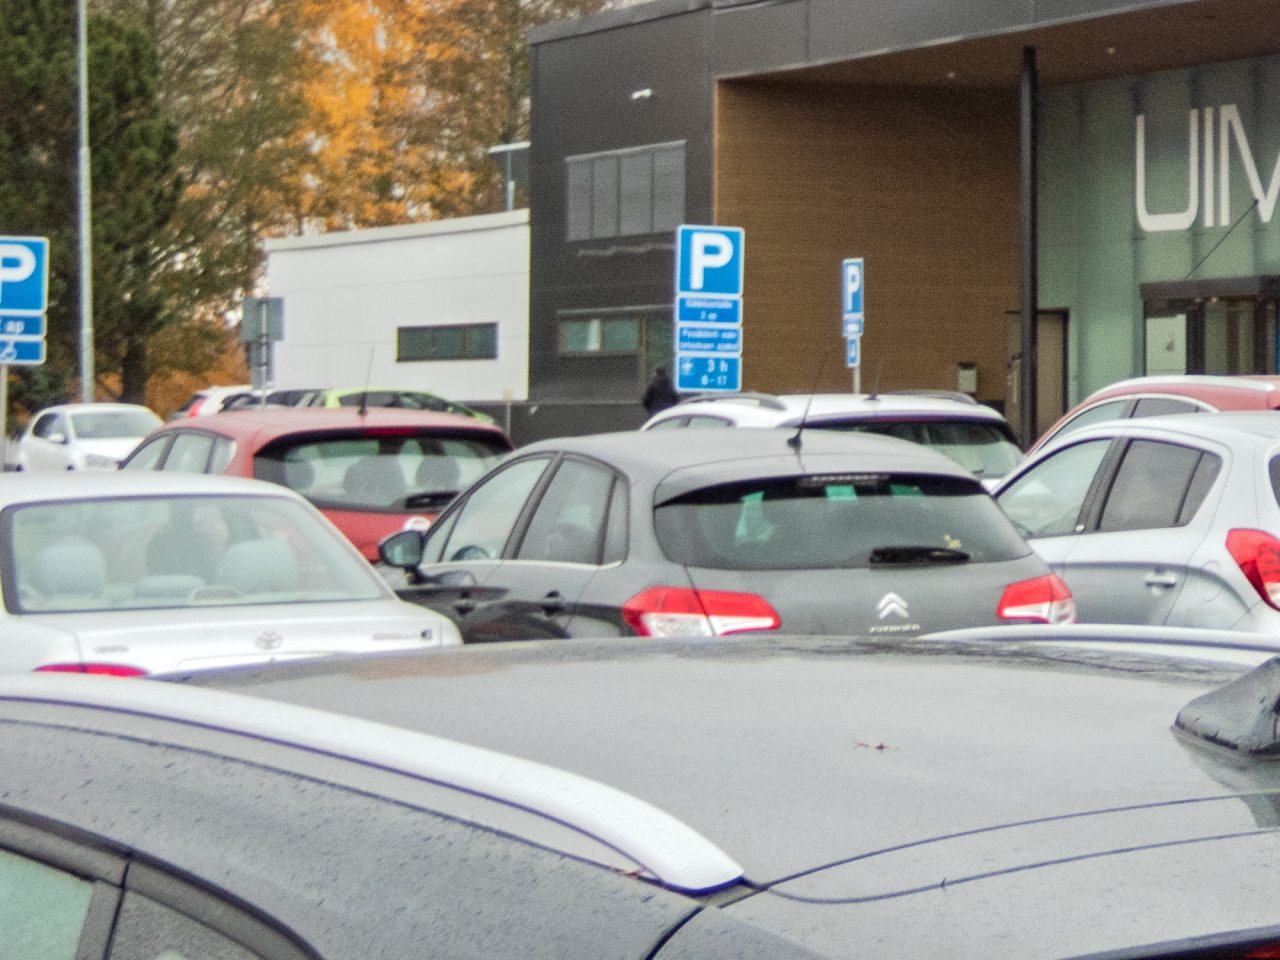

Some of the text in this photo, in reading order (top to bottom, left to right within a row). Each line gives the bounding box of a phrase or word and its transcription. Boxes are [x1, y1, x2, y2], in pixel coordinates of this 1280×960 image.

[0, 243, 37, 305] P
[690, 232, 734, 290] P
[847, 265, 860, 311] P
